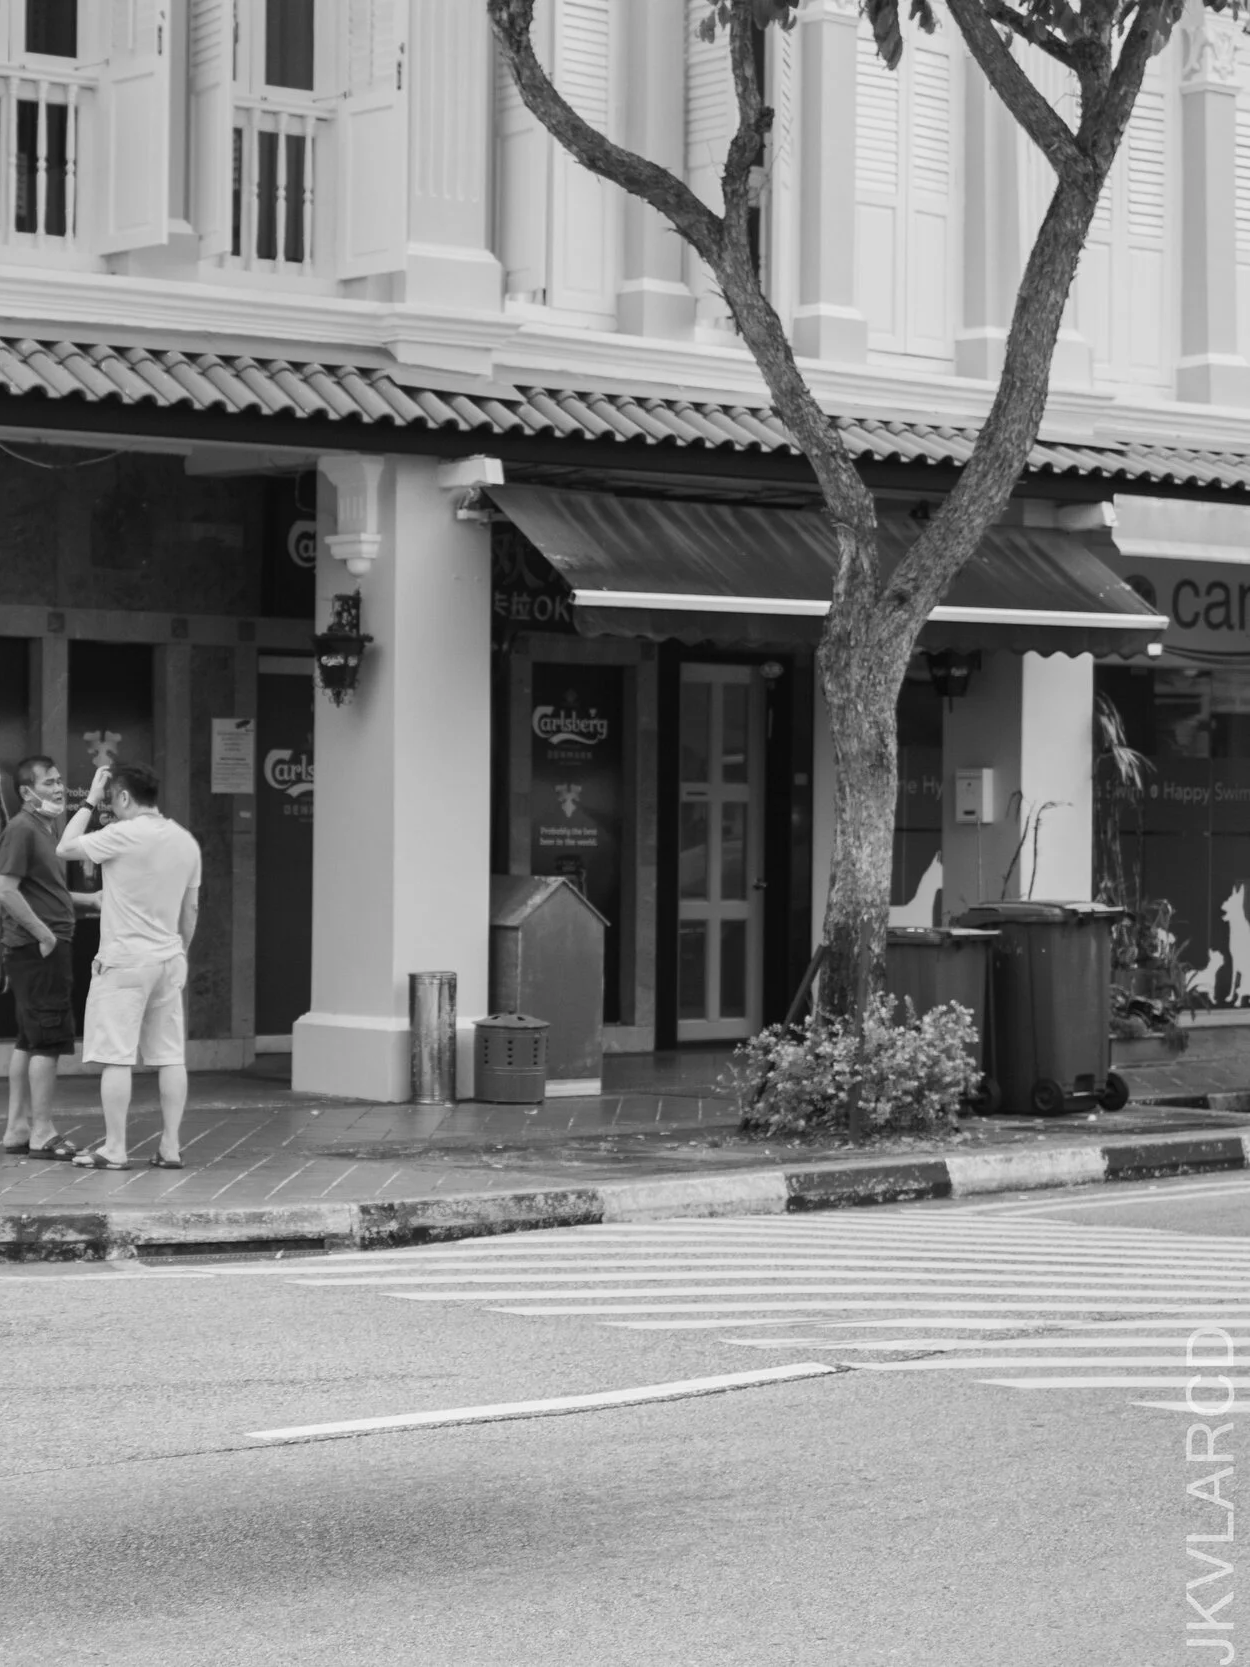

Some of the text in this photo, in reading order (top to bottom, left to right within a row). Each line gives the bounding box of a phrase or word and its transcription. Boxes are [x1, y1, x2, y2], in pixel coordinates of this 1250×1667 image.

[532, 706, 608, 740] Carlsberg
[264, 749, 314, 790] Carls
[1163, 780, 1210, 805] Happy
